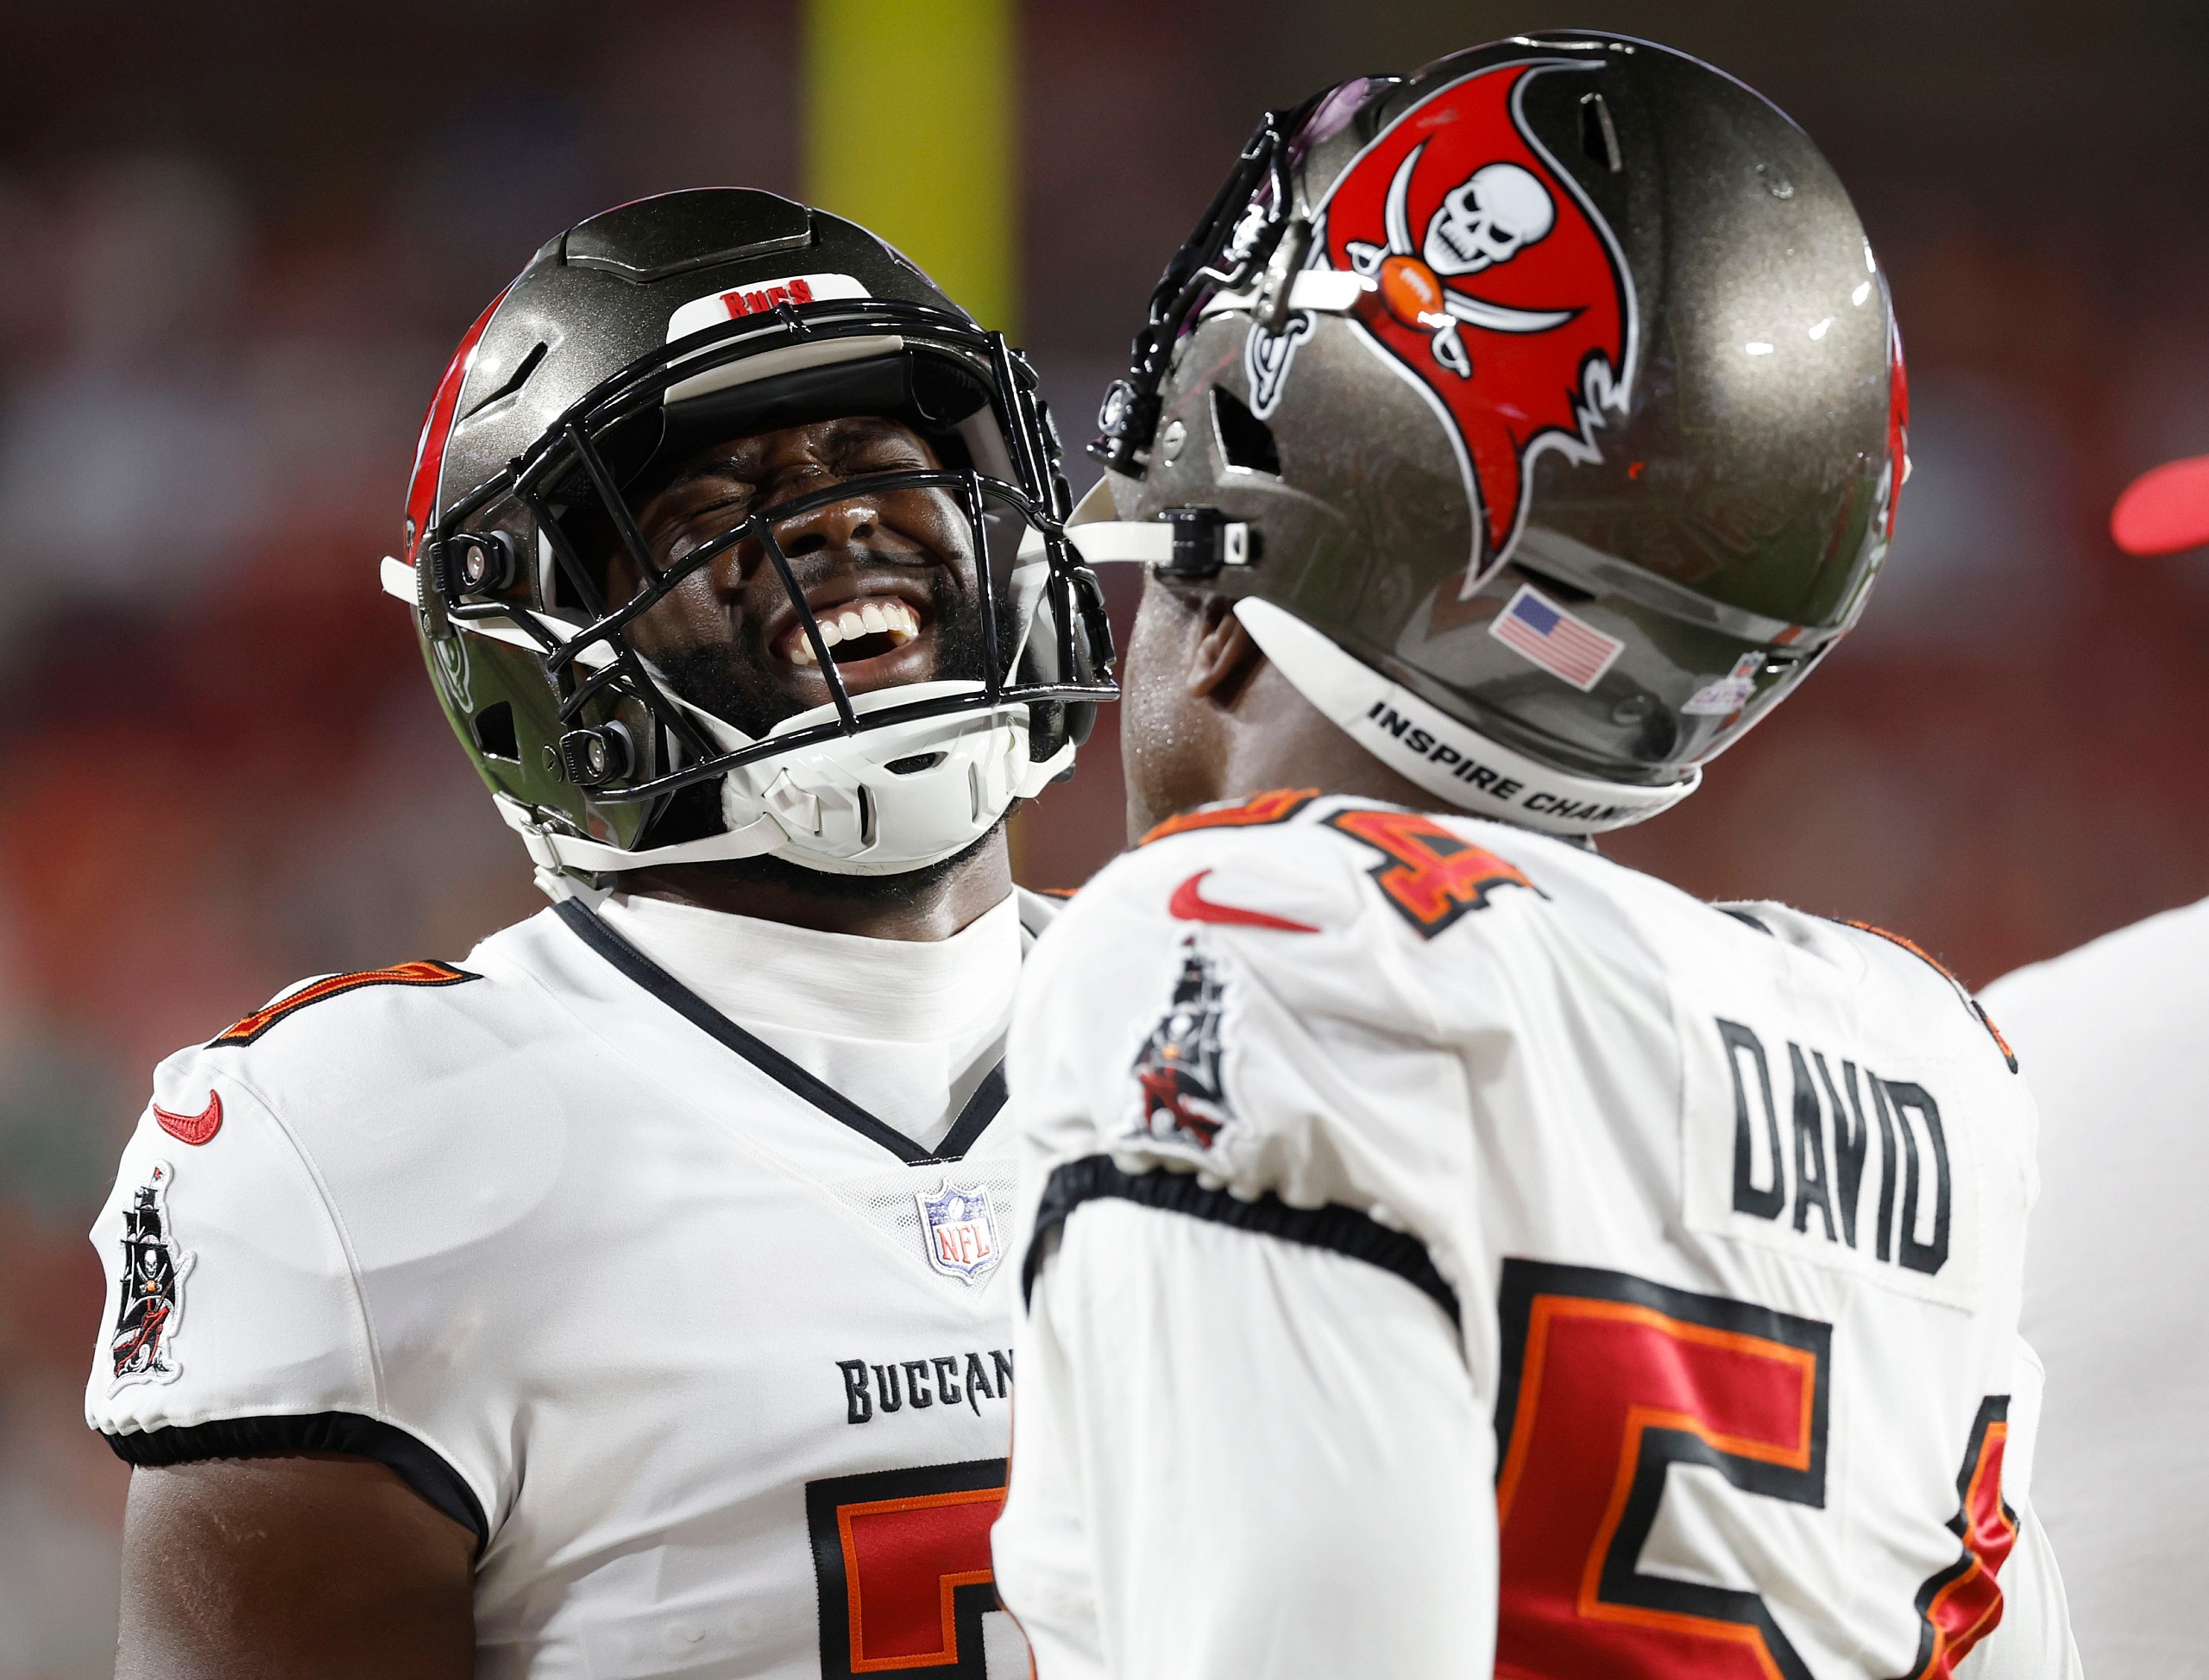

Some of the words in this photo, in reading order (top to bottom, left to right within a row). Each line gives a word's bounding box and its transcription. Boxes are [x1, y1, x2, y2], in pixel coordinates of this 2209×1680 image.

[1368, 701, 1523, 800] INSPIRE
[1714, 1016, 1951, 1276] DAVID
[937, 1224, 991, 1264] NFL
